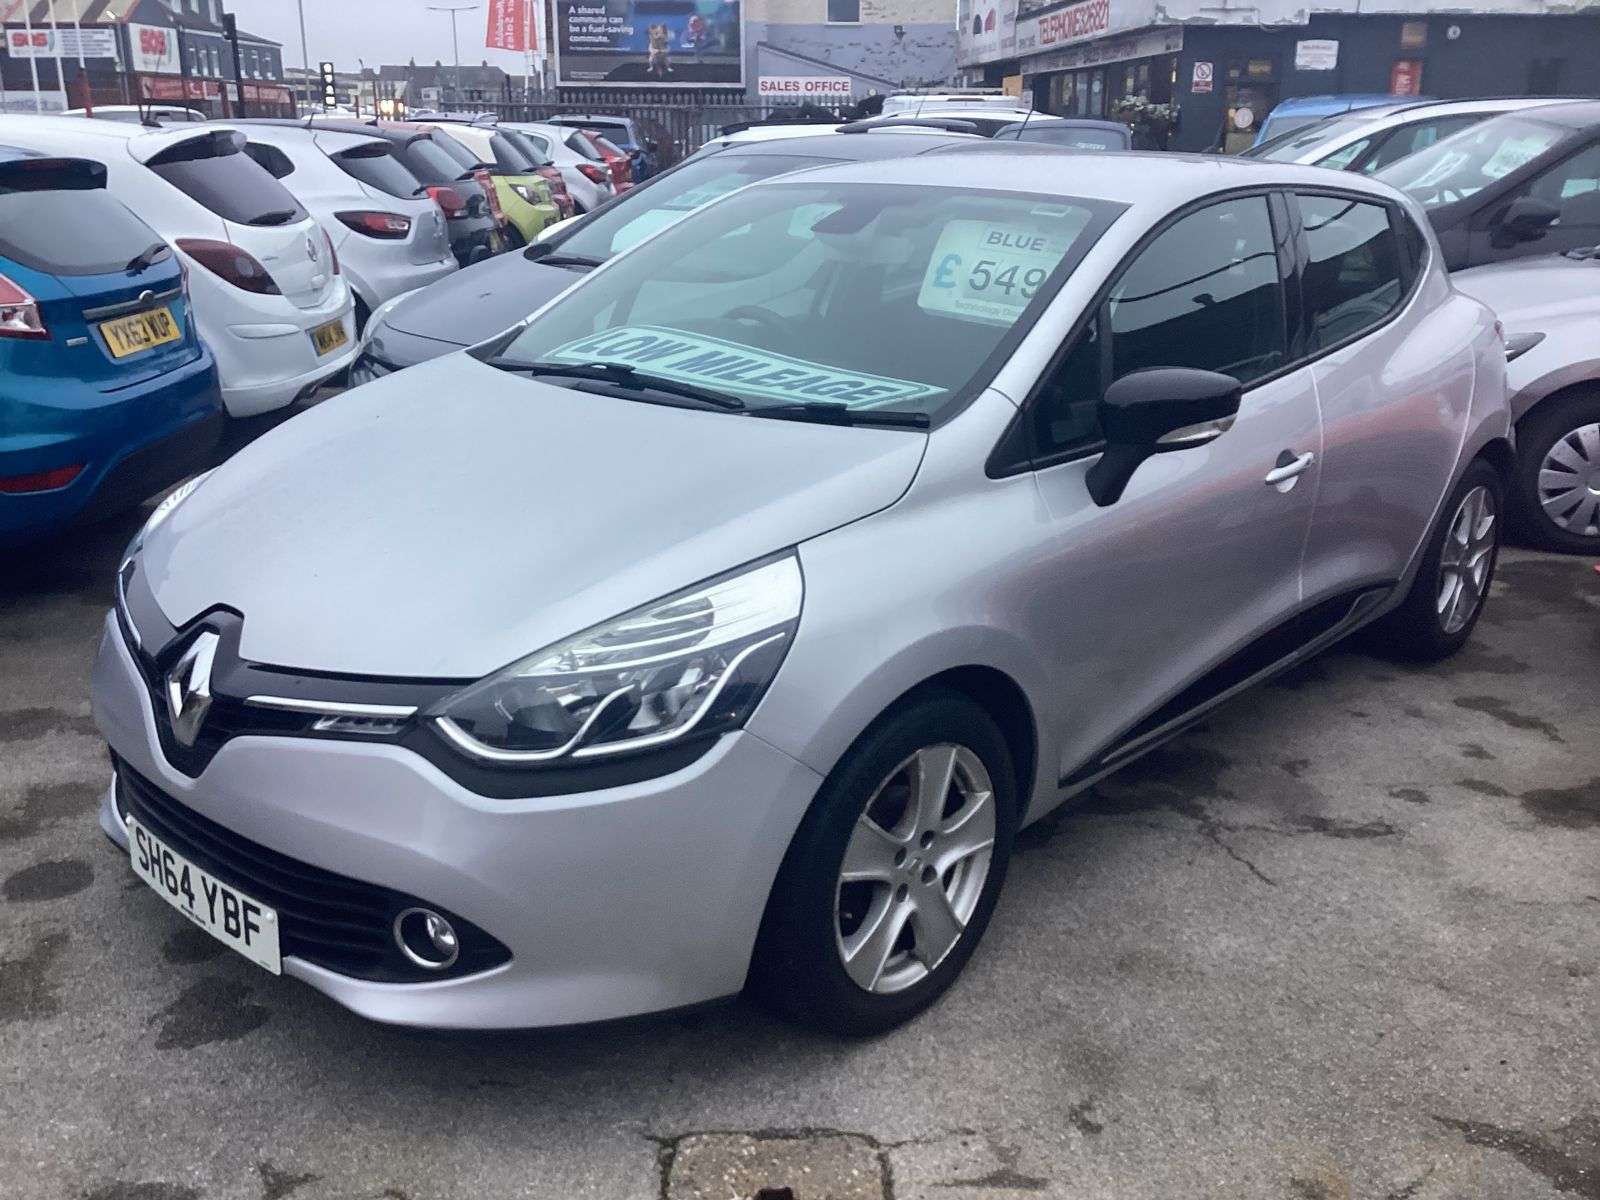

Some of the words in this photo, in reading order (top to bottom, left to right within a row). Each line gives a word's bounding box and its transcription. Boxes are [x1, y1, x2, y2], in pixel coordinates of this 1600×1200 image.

[568, 6, 576, 14] A
[577, 5, 606, 15] shared
[568, 16, 608, 24] commute
[568, 24, 581, 33] be
[588, 24, 634, 35] fuel-saving
[760, 80, 801, 92] SALES
[804, 80, 850, 92] OFFICE
[986, 230, 1047, 252] BLUE
[572, 331, 699, 363] LOW
[664, 349, 897, 401] MILEAGE
[135, 826, 196, 909] SH64
[200, 874, 262, 947] YBF
